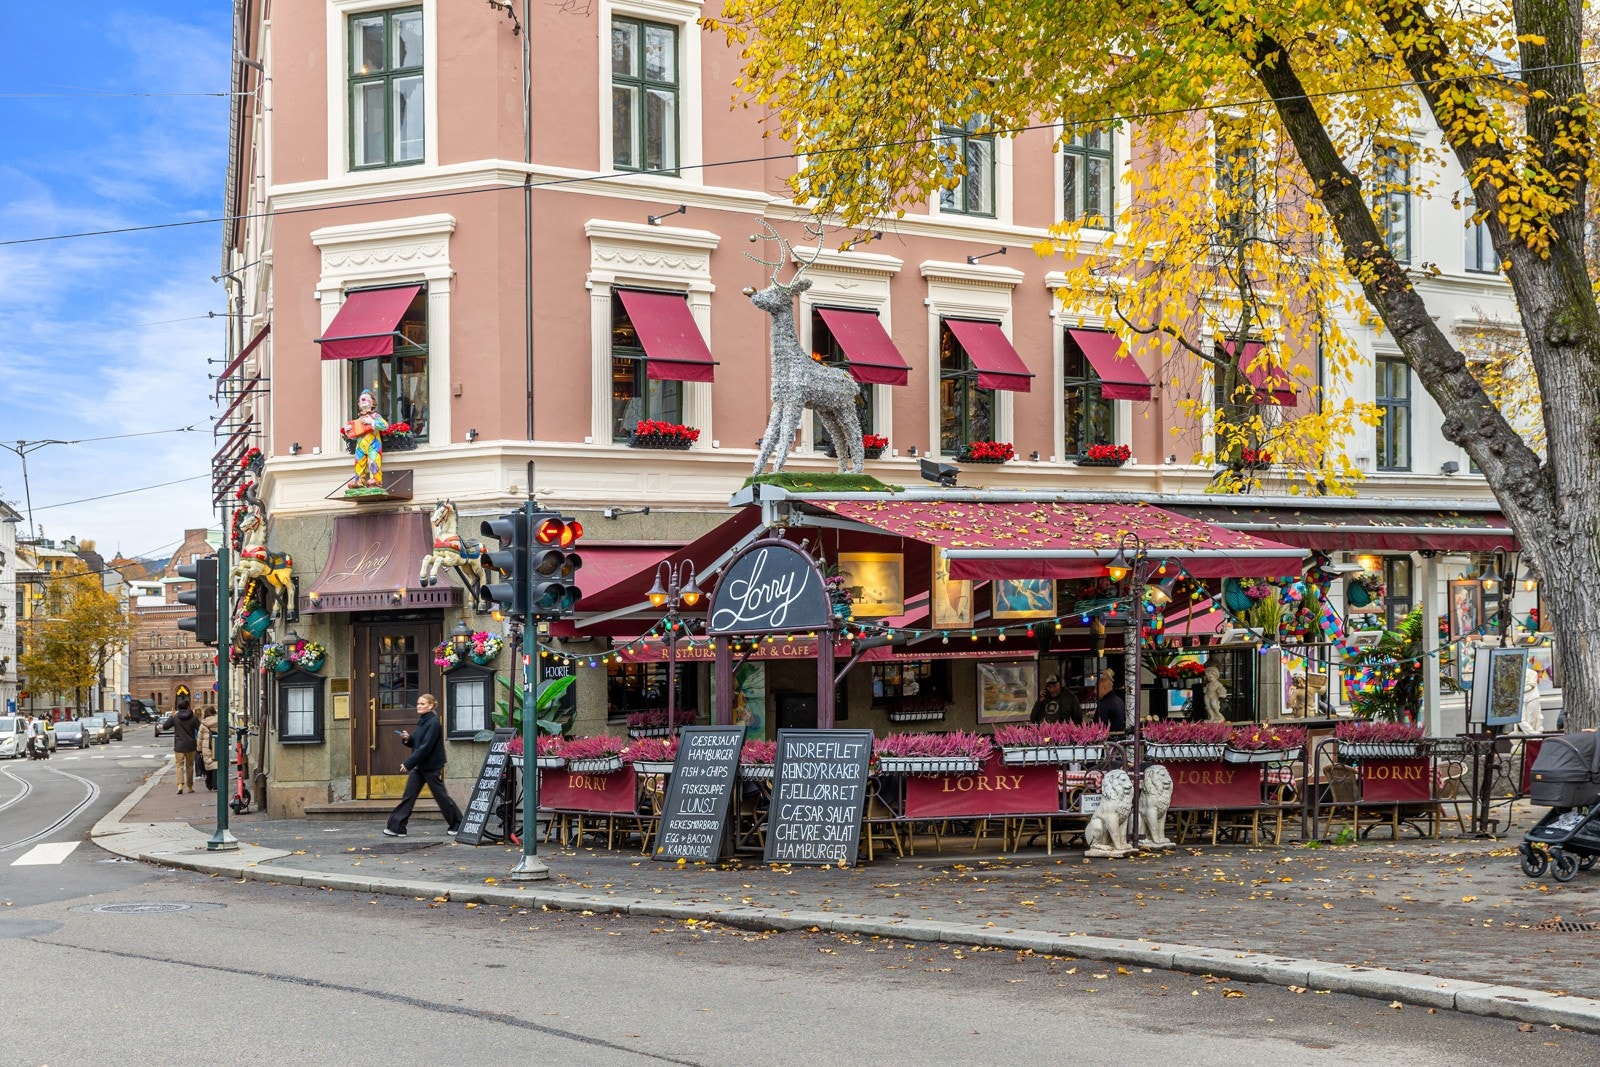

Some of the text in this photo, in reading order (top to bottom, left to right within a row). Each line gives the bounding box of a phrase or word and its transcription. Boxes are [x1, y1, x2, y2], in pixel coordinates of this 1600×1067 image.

[326, 542, 395, 584] Lorry
[712, 549, 810, 631] Lorry
[770, 645, 779, 656] &
[782, 644, 810, 656] CAFE
[688, 749, 733, 761] HAMBURGER
[786, 742, 863, 759] INDREFILET
[681, 766, 699, 777] FISH
[706, 766, 728, 778] CHIPS
[781, 762, 860, 779] REINSDYRKAKER
[1179, 770, 1235, 785] LORRY
[1367, 765, 1424, 780] LORRY
[569, 775, 607, 791] LORRY
[681, 783, 726, 795] FISKESUPPE
[942, 775, 1024, 792] LORRY
[780, 783, 858, 800] FJELLØRRET
[680, 798, 717, 813] LUNSJ
[781, 804, 857, 823] CÆSAR SALAT
[665, 833, 679, 843] EGG
[687, 833, 714, 844] BACON
[775, 824, 854, 841] CHEVRE SALAT
[667, 845, 710, 857] KARBONADE
[776, 843, 848, 860] HAMBURGER
